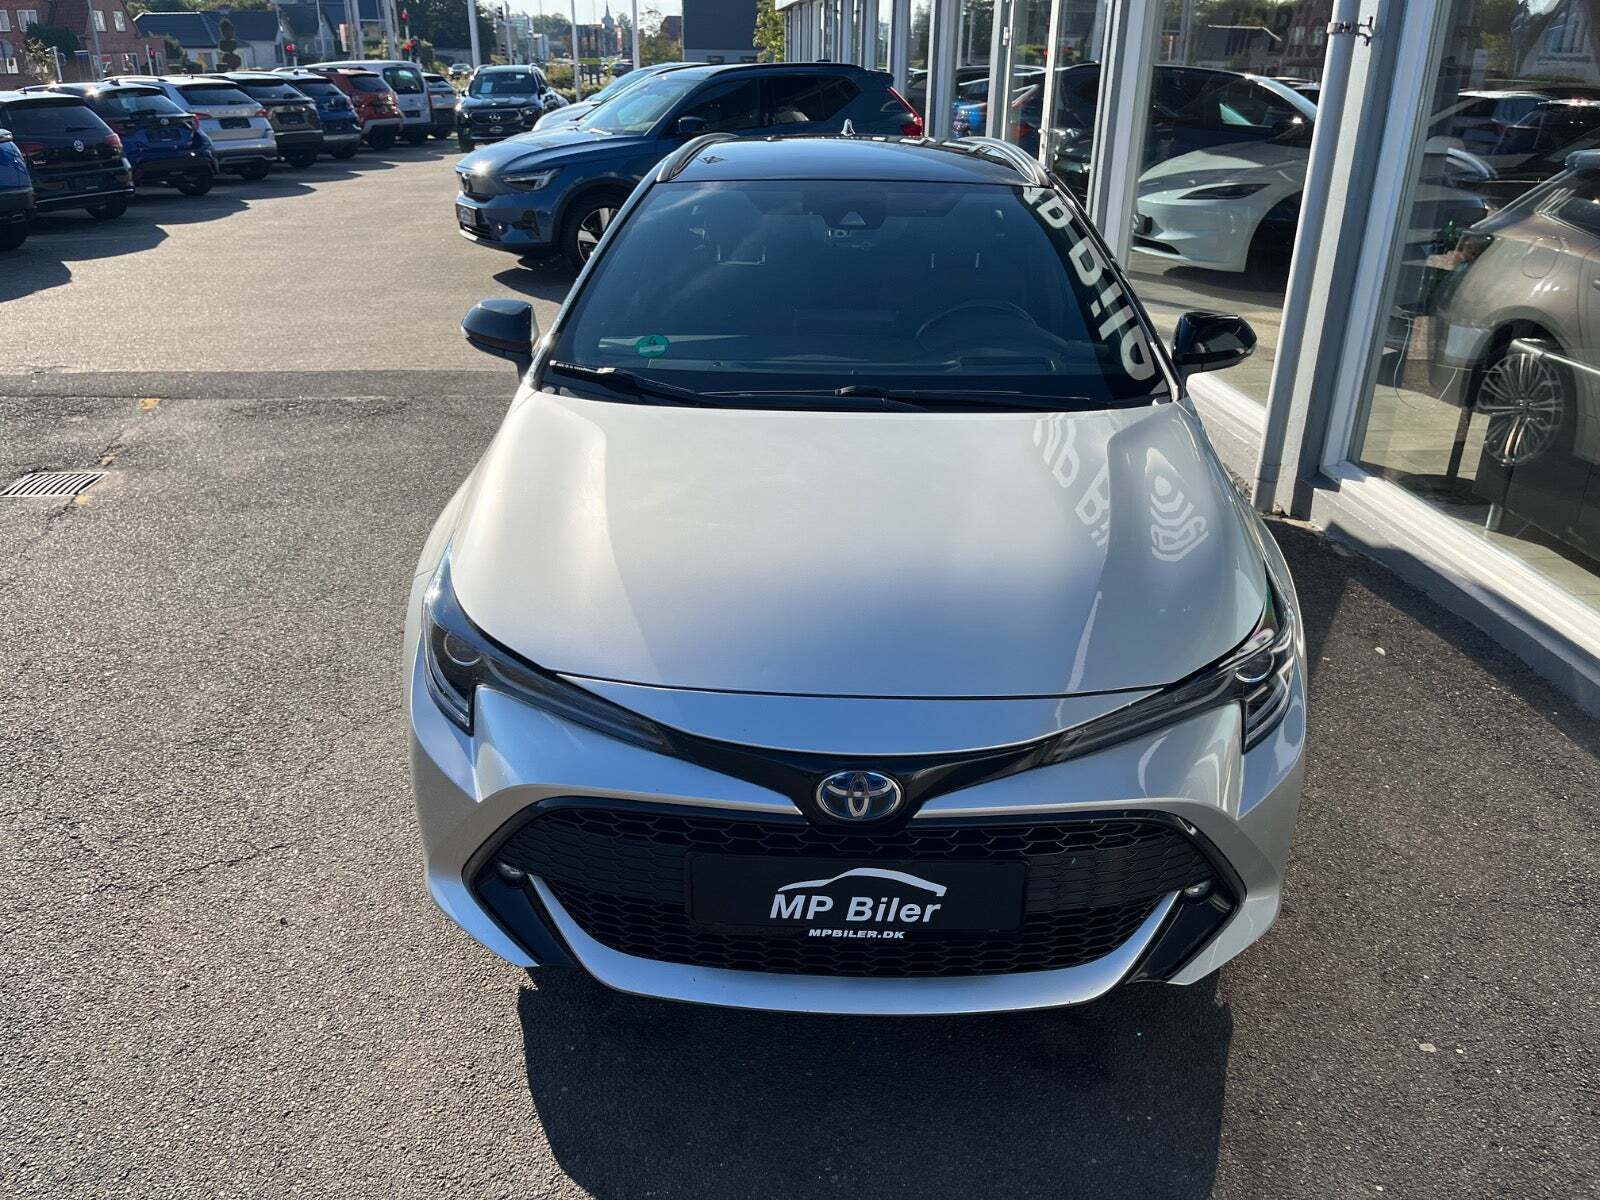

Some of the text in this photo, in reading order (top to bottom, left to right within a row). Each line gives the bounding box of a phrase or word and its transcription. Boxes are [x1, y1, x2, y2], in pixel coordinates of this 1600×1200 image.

[770, 894, 941, 923] MP Biler
[808, 929, 906, 939] MPBILER.DK
